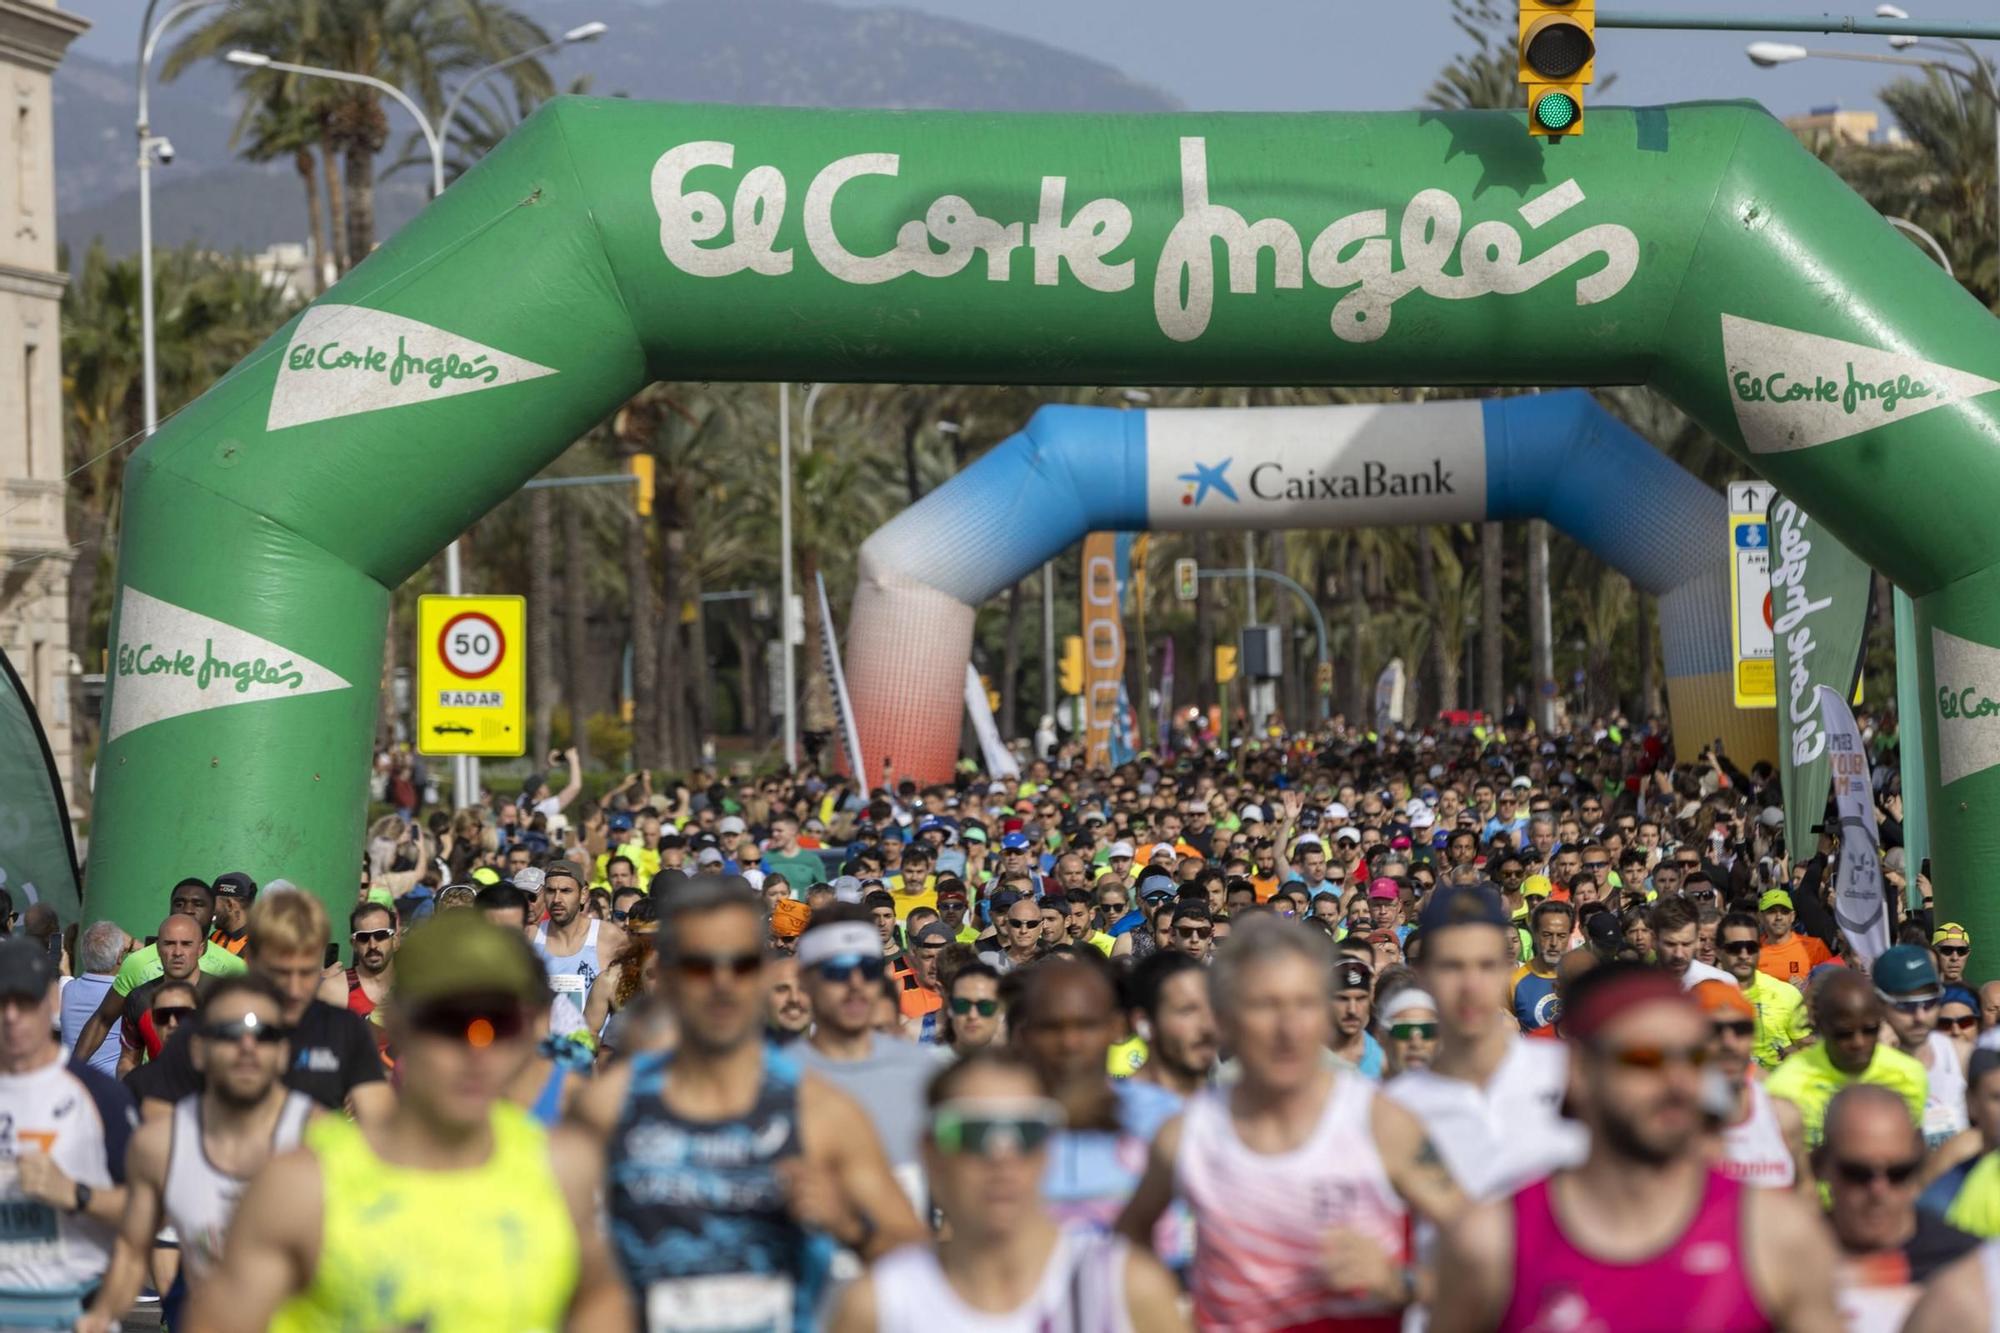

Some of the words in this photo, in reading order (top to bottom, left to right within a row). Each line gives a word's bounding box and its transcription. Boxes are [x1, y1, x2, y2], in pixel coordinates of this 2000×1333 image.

[650, 140, 794, 277] El
[803, 153, 1135, 293] Corte
[1153, 136, 1640, 343] Inglés
[288, 342, 316, 371] El
[317, 342, 388, 374] Corte
[389, 335, 500, 389] Inglés
[1733, 371, 1766, 402] El
[1766, 372, 1839, 404] Corte
[1249, 459, 1456, 502] CaixaBank
[454, 633, 491, 656] 50
[118, 643, 135, 677] El
[136, 643, 195, 677] Corte
[197, 638, 304, 693] Inglés
[440, 692, 502, 706] RADAR
[1938, 685, 1960, 720] El
